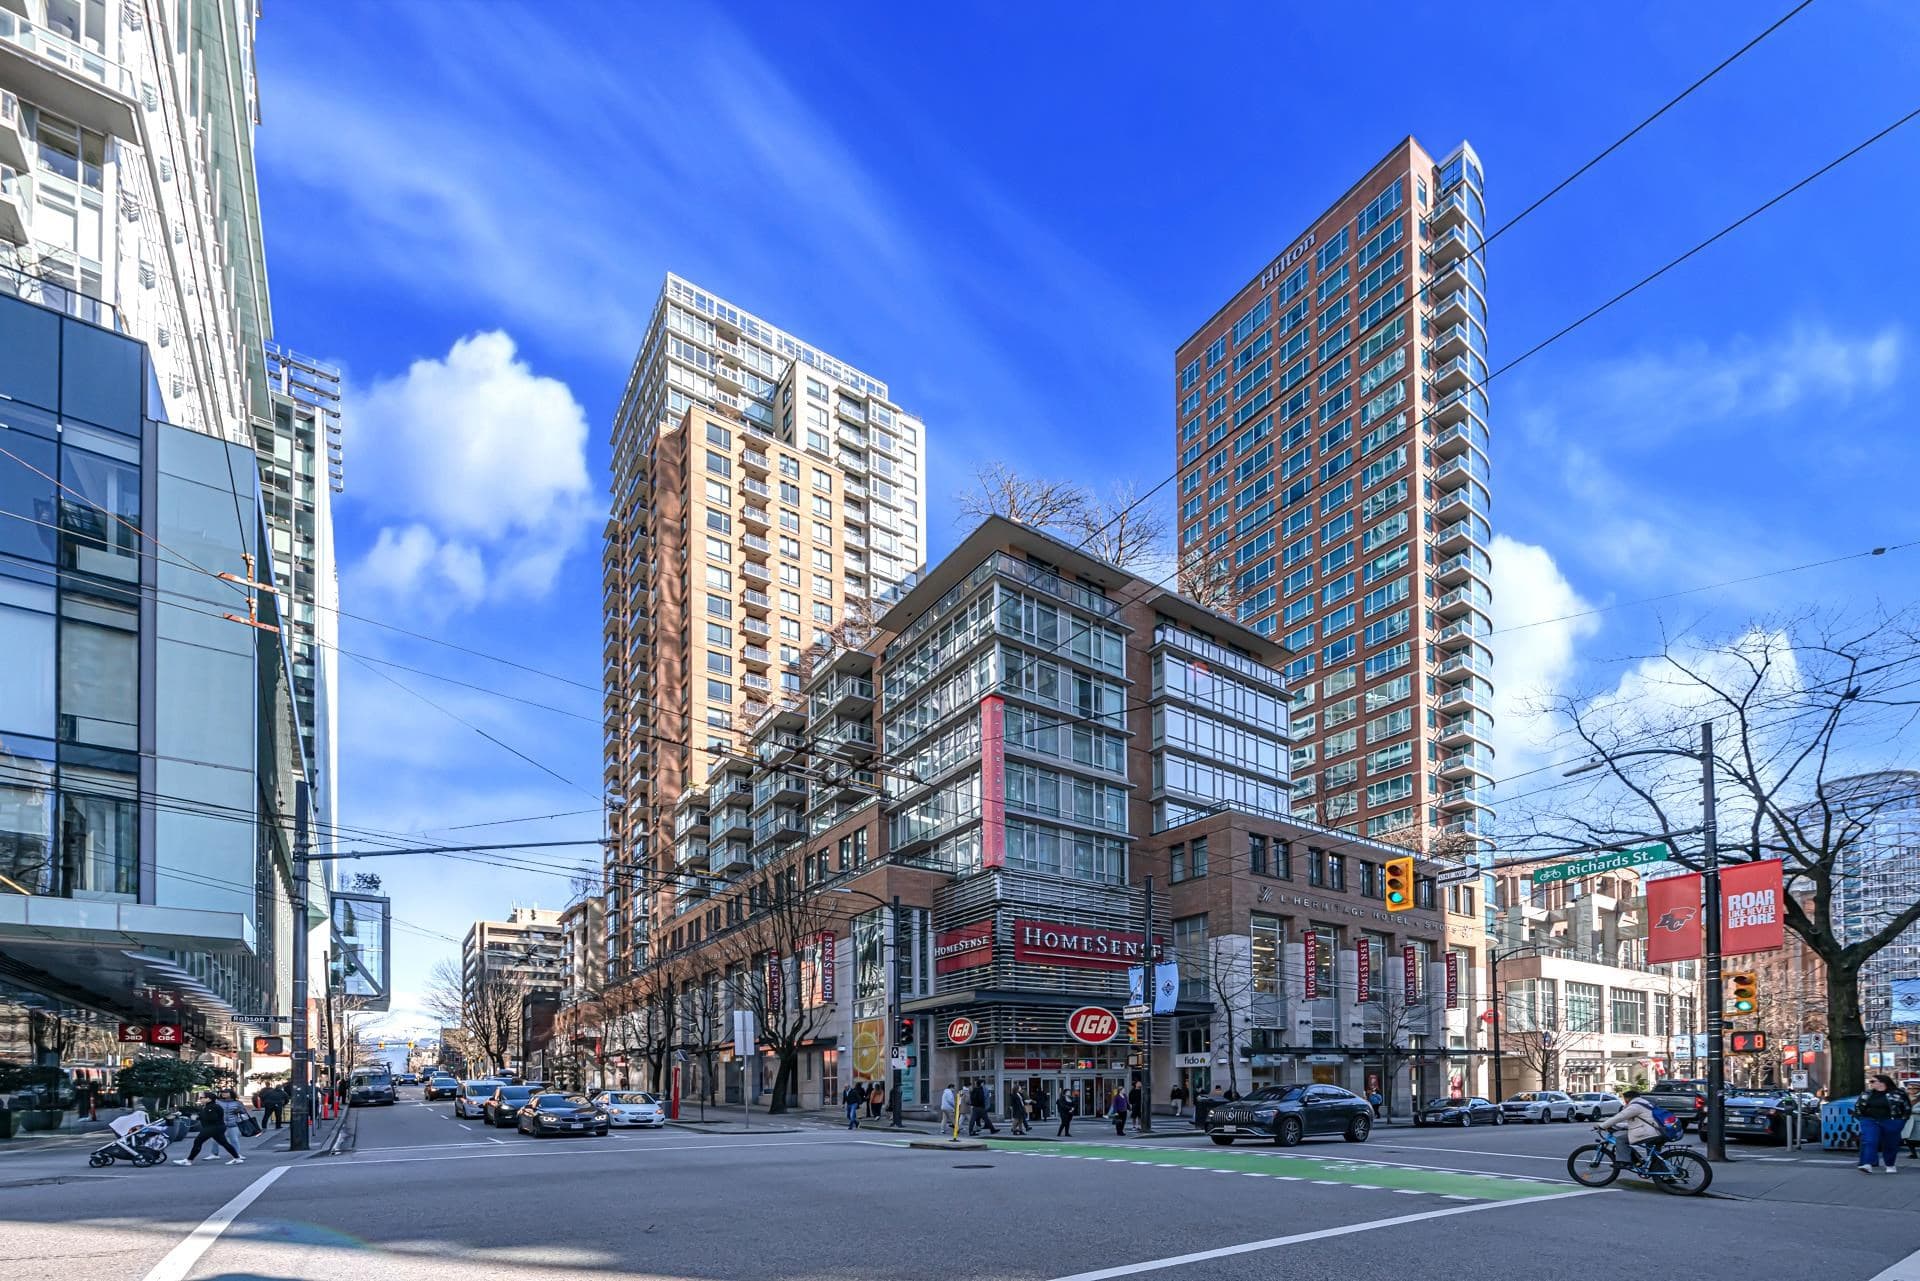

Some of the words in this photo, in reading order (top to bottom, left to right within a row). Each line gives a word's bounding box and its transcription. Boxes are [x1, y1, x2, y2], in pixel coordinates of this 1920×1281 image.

[1261, 233, 1316, 290] Hilton
[1567, 855, 1629, 875] Richards
[1632, 850, 1654, 864] St.
[1728, 889, 1775, 911] ROAR
[1728, 910, 1746, 919] LIKE
[1748, 904, 1776, 916] NEVER
[1728, 913, 1776, 929] BEFORE
[951, 1022, 969, 1038] IGA
[1076, 1014, 1110, 1034] IGA
[1753, 1034, 1764, 1050] 8
[1184, 1056, 1199, 1065] fido
